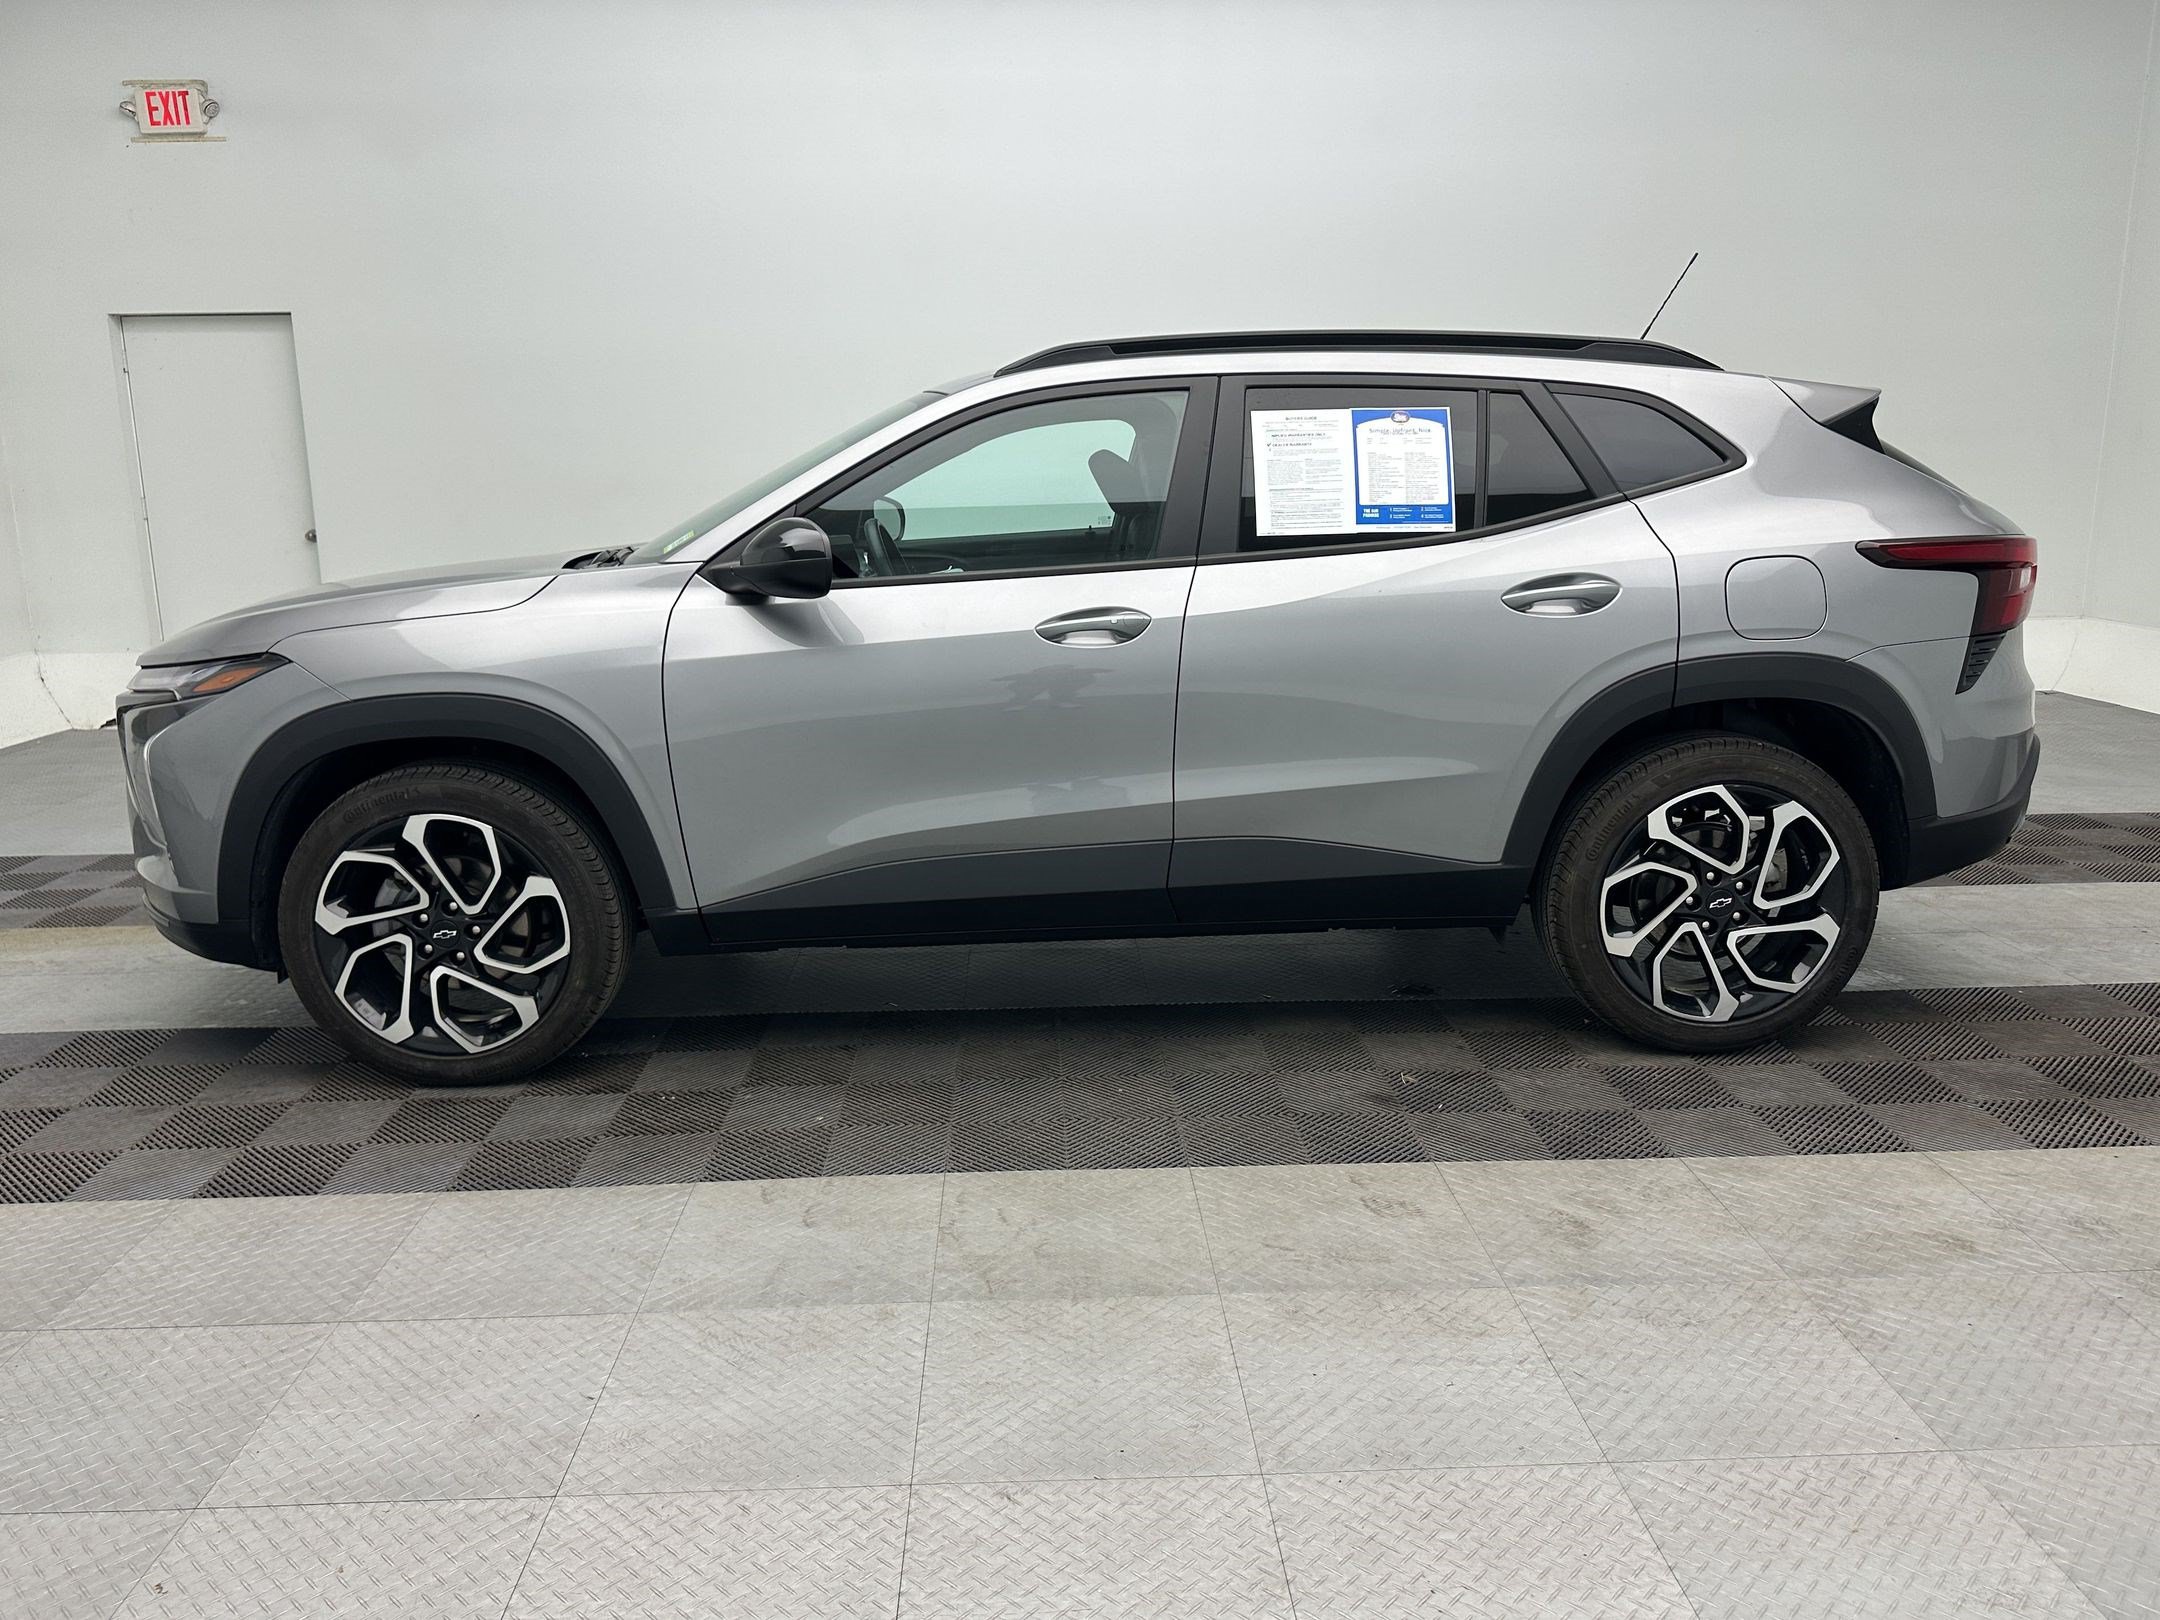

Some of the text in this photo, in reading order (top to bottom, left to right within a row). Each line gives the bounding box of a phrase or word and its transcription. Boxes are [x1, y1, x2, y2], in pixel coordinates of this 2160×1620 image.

[145, 90, 191, 127] EXIT
[343, 787, 409, 823] Continental
[1585, 800, 1633, 861] Continental
